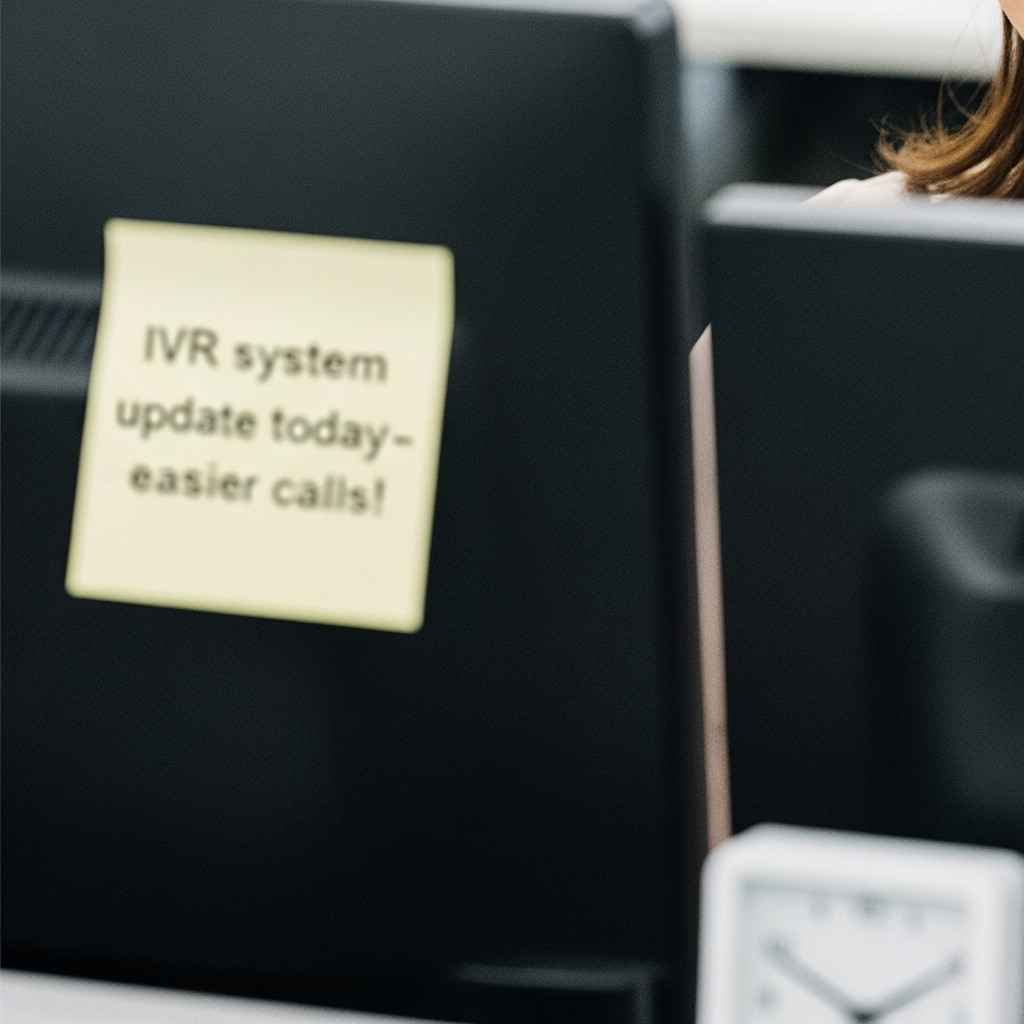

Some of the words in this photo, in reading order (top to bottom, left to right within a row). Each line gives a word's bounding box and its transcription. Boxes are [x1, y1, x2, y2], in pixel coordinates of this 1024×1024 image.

[143, 324, 219, 369] IVR
[233, 341, 388, 384] system
[115, 396, 257, 441] update
[128, 462, 259, 502] easier
[270, 473, 387, 518] calls!
